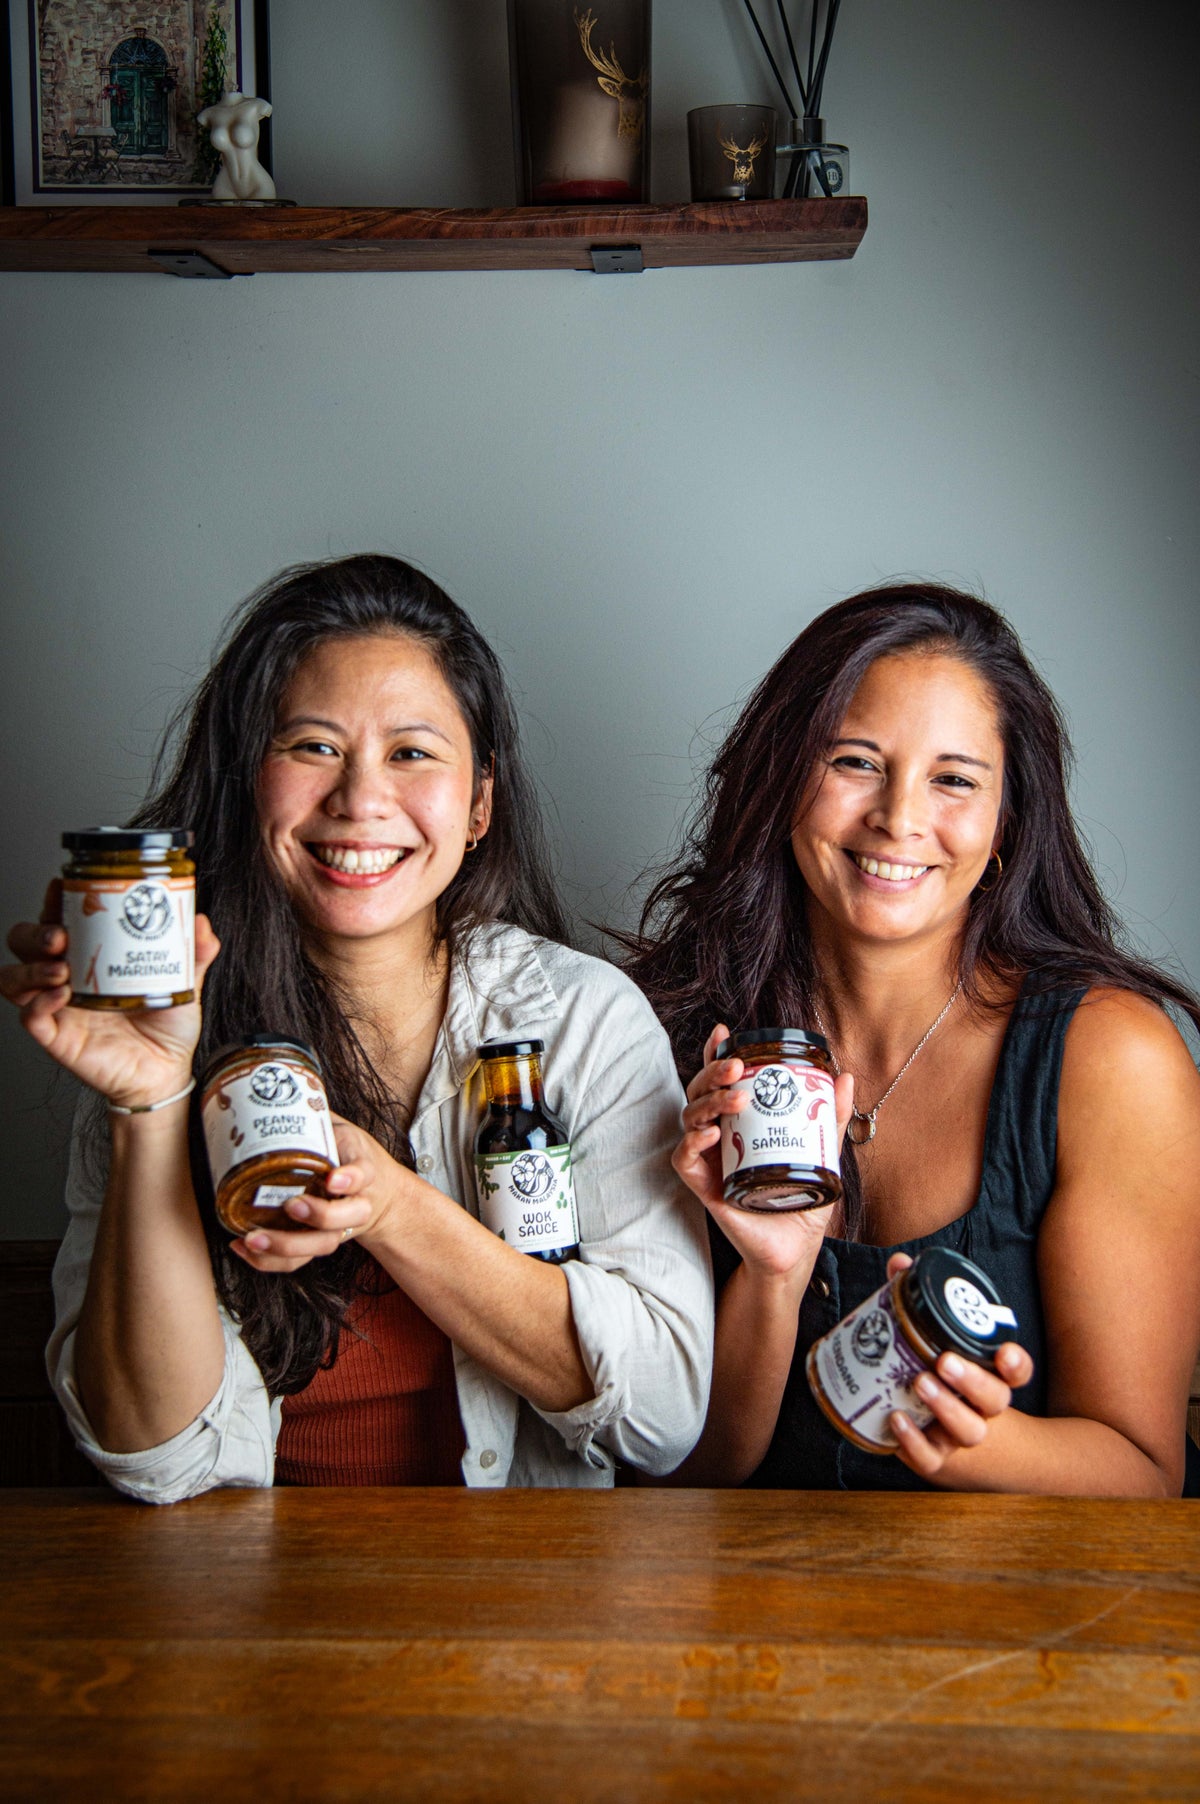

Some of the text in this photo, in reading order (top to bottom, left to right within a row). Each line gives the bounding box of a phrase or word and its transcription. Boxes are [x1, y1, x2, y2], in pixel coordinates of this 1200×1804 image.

[126, 951, 170, 963] SATAY
[107, 961, 182, 977] MARINADE
[750, 1098, 772, 1117] MAKAN
[253, 1115, 306, 1129] PEANUT
[260, 1126, 305, 1138] SAUCE
[767, 1127, 789, 1136] THE
[752, 1136, 806, 1150] SAMBAL
[508, 1179, 558, 1205] MAKAN MALAYSIA
[522, 1211, 552, 1224] WOK
[518, 1221, 559, 1237] SAUCE
